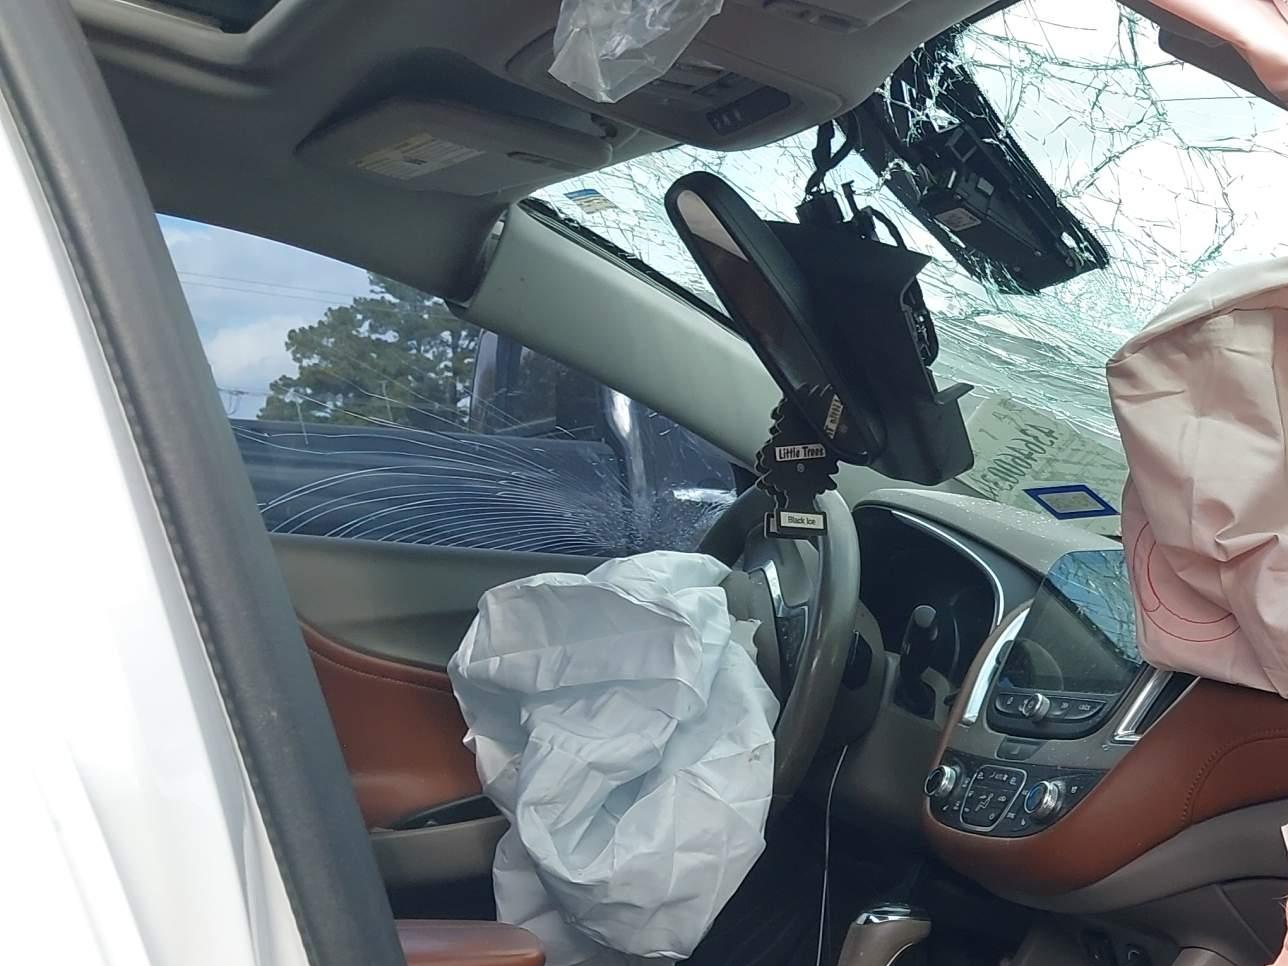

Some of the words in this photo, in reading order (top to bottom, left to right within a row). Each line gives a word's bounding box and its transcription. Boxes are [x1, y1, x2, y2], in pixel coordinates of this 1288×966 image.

[779, 447, 800, 460] Little
[801, 446, 825, 458] Trees
[787, 515, 805, 525] Black
[806, 517, 817, 526] Ice
